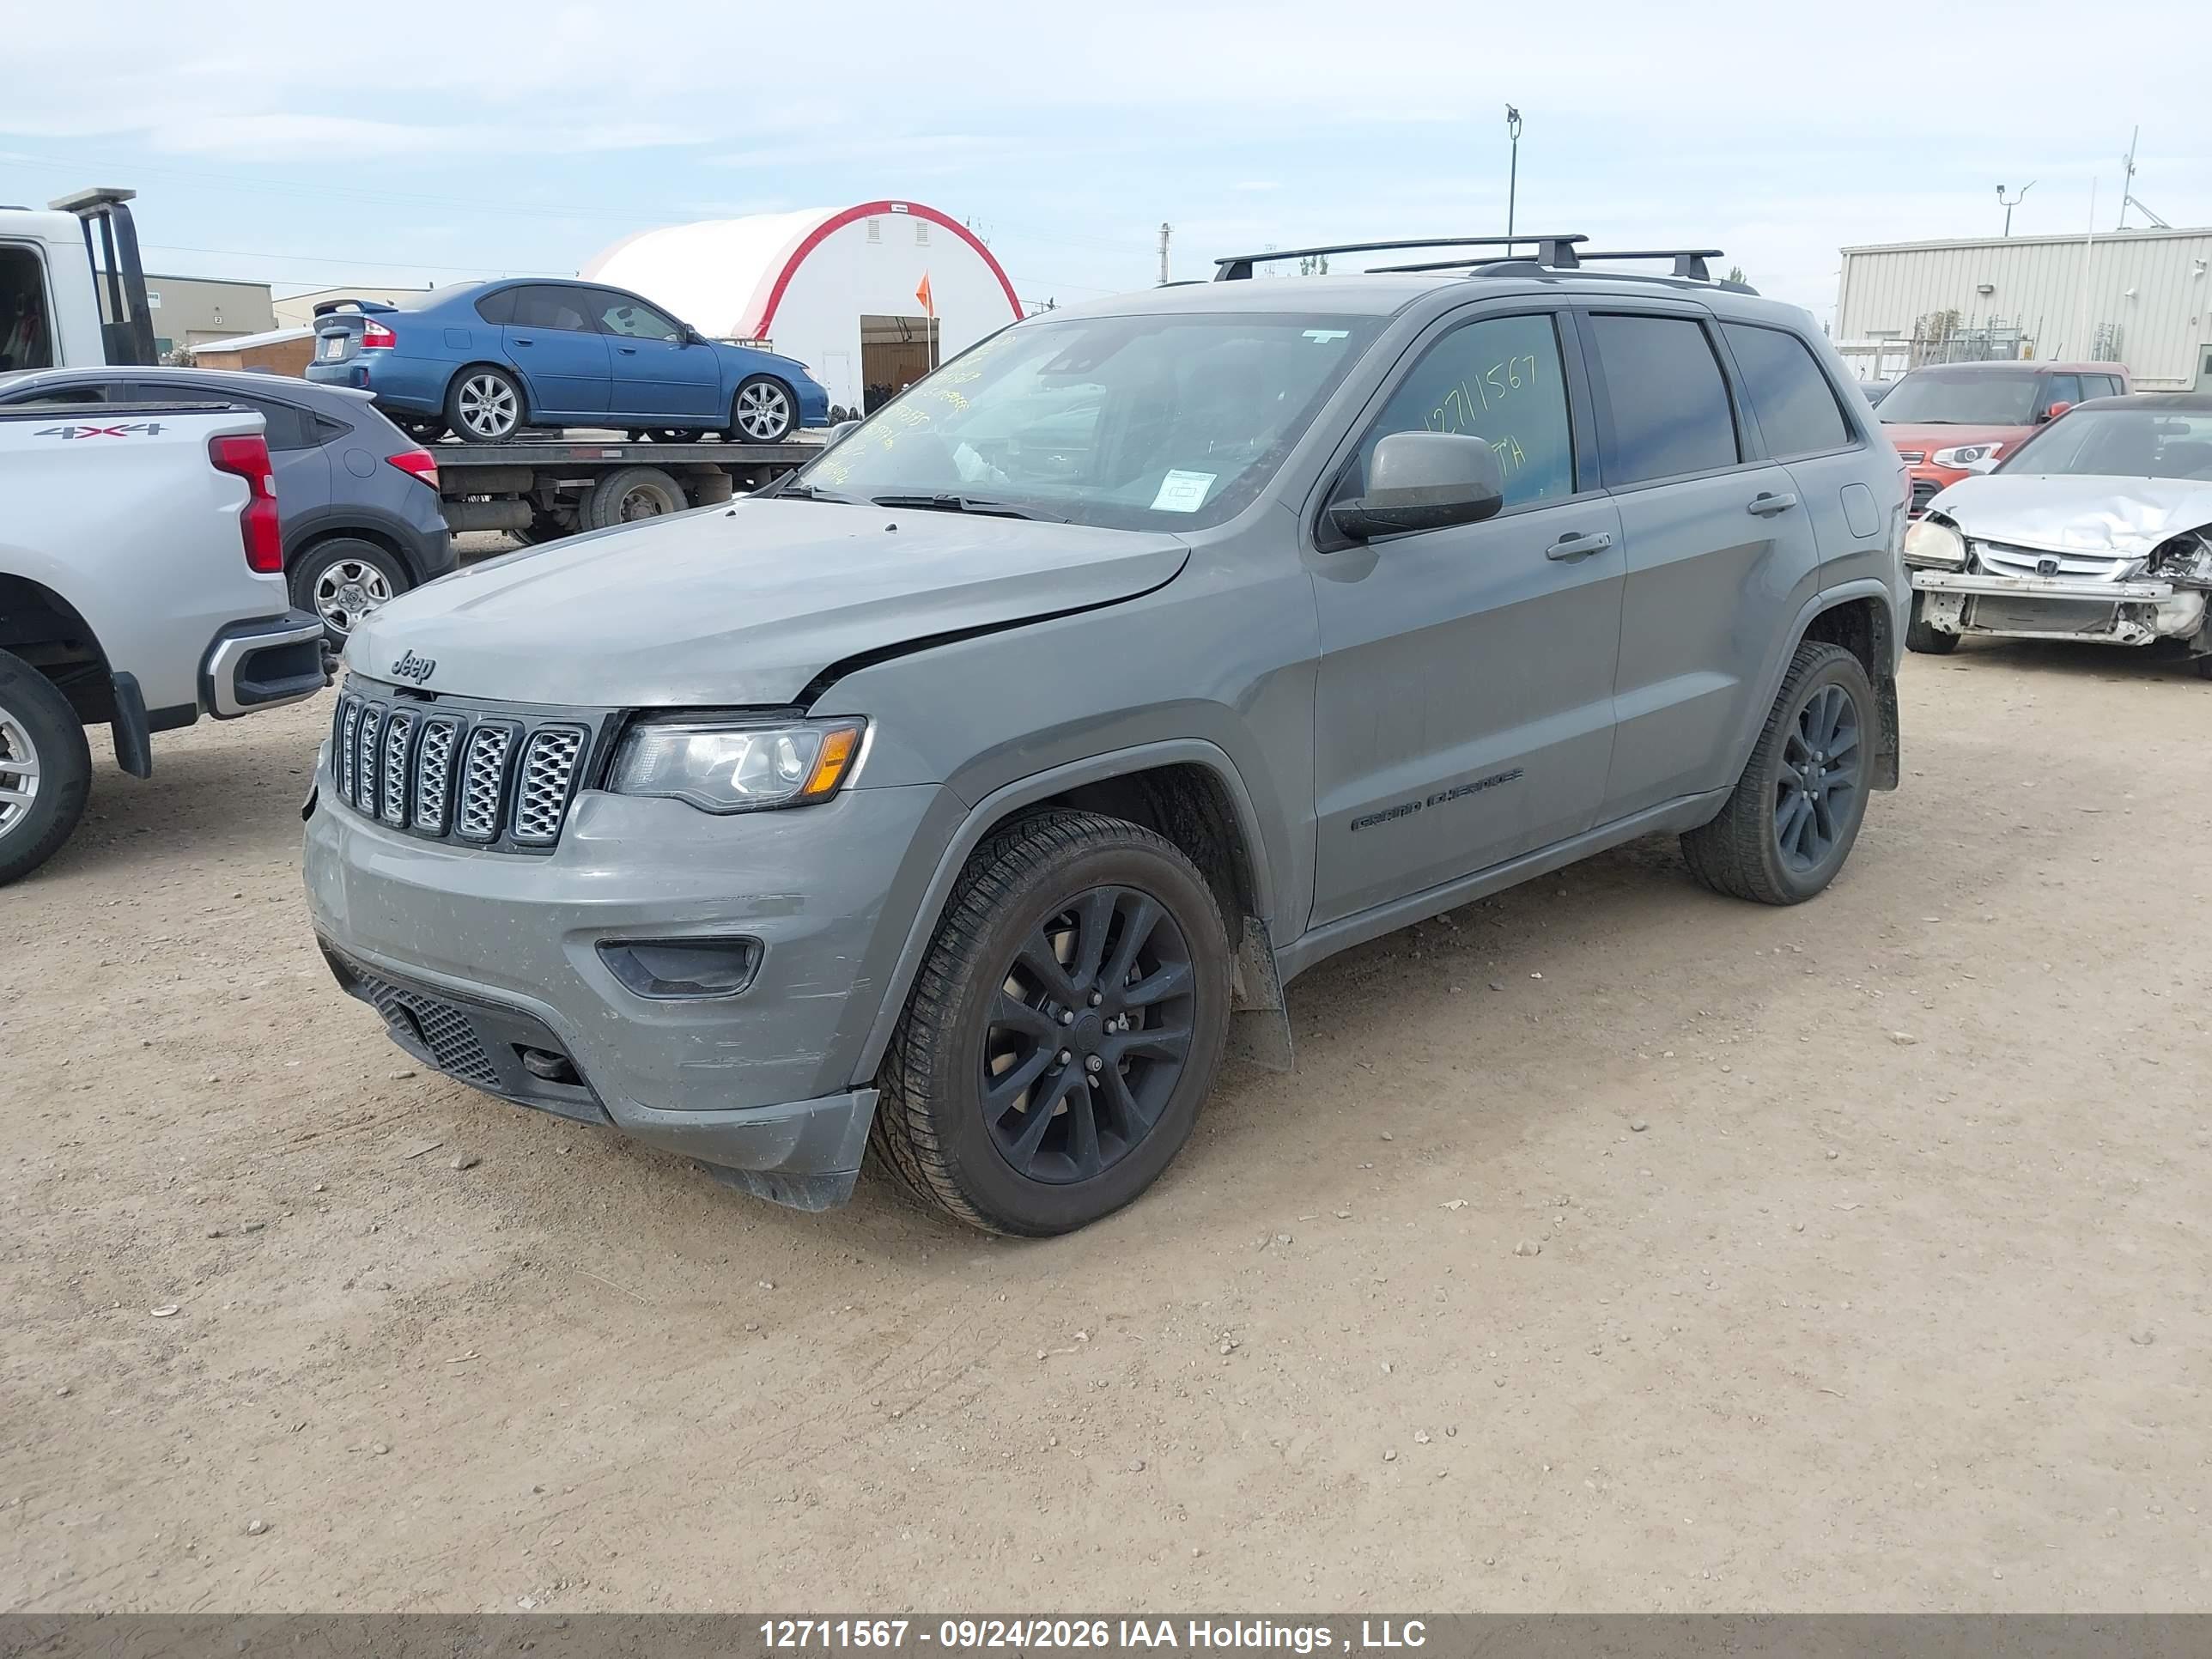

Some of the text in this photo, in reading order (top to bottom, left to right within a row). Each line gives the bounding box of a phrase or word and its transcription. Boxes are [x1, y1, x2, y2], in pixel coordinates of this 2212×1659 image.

[391, 648, 436, 686] Jeep
[1351, 768, 1525, 832] GRAND CHEROKEE
